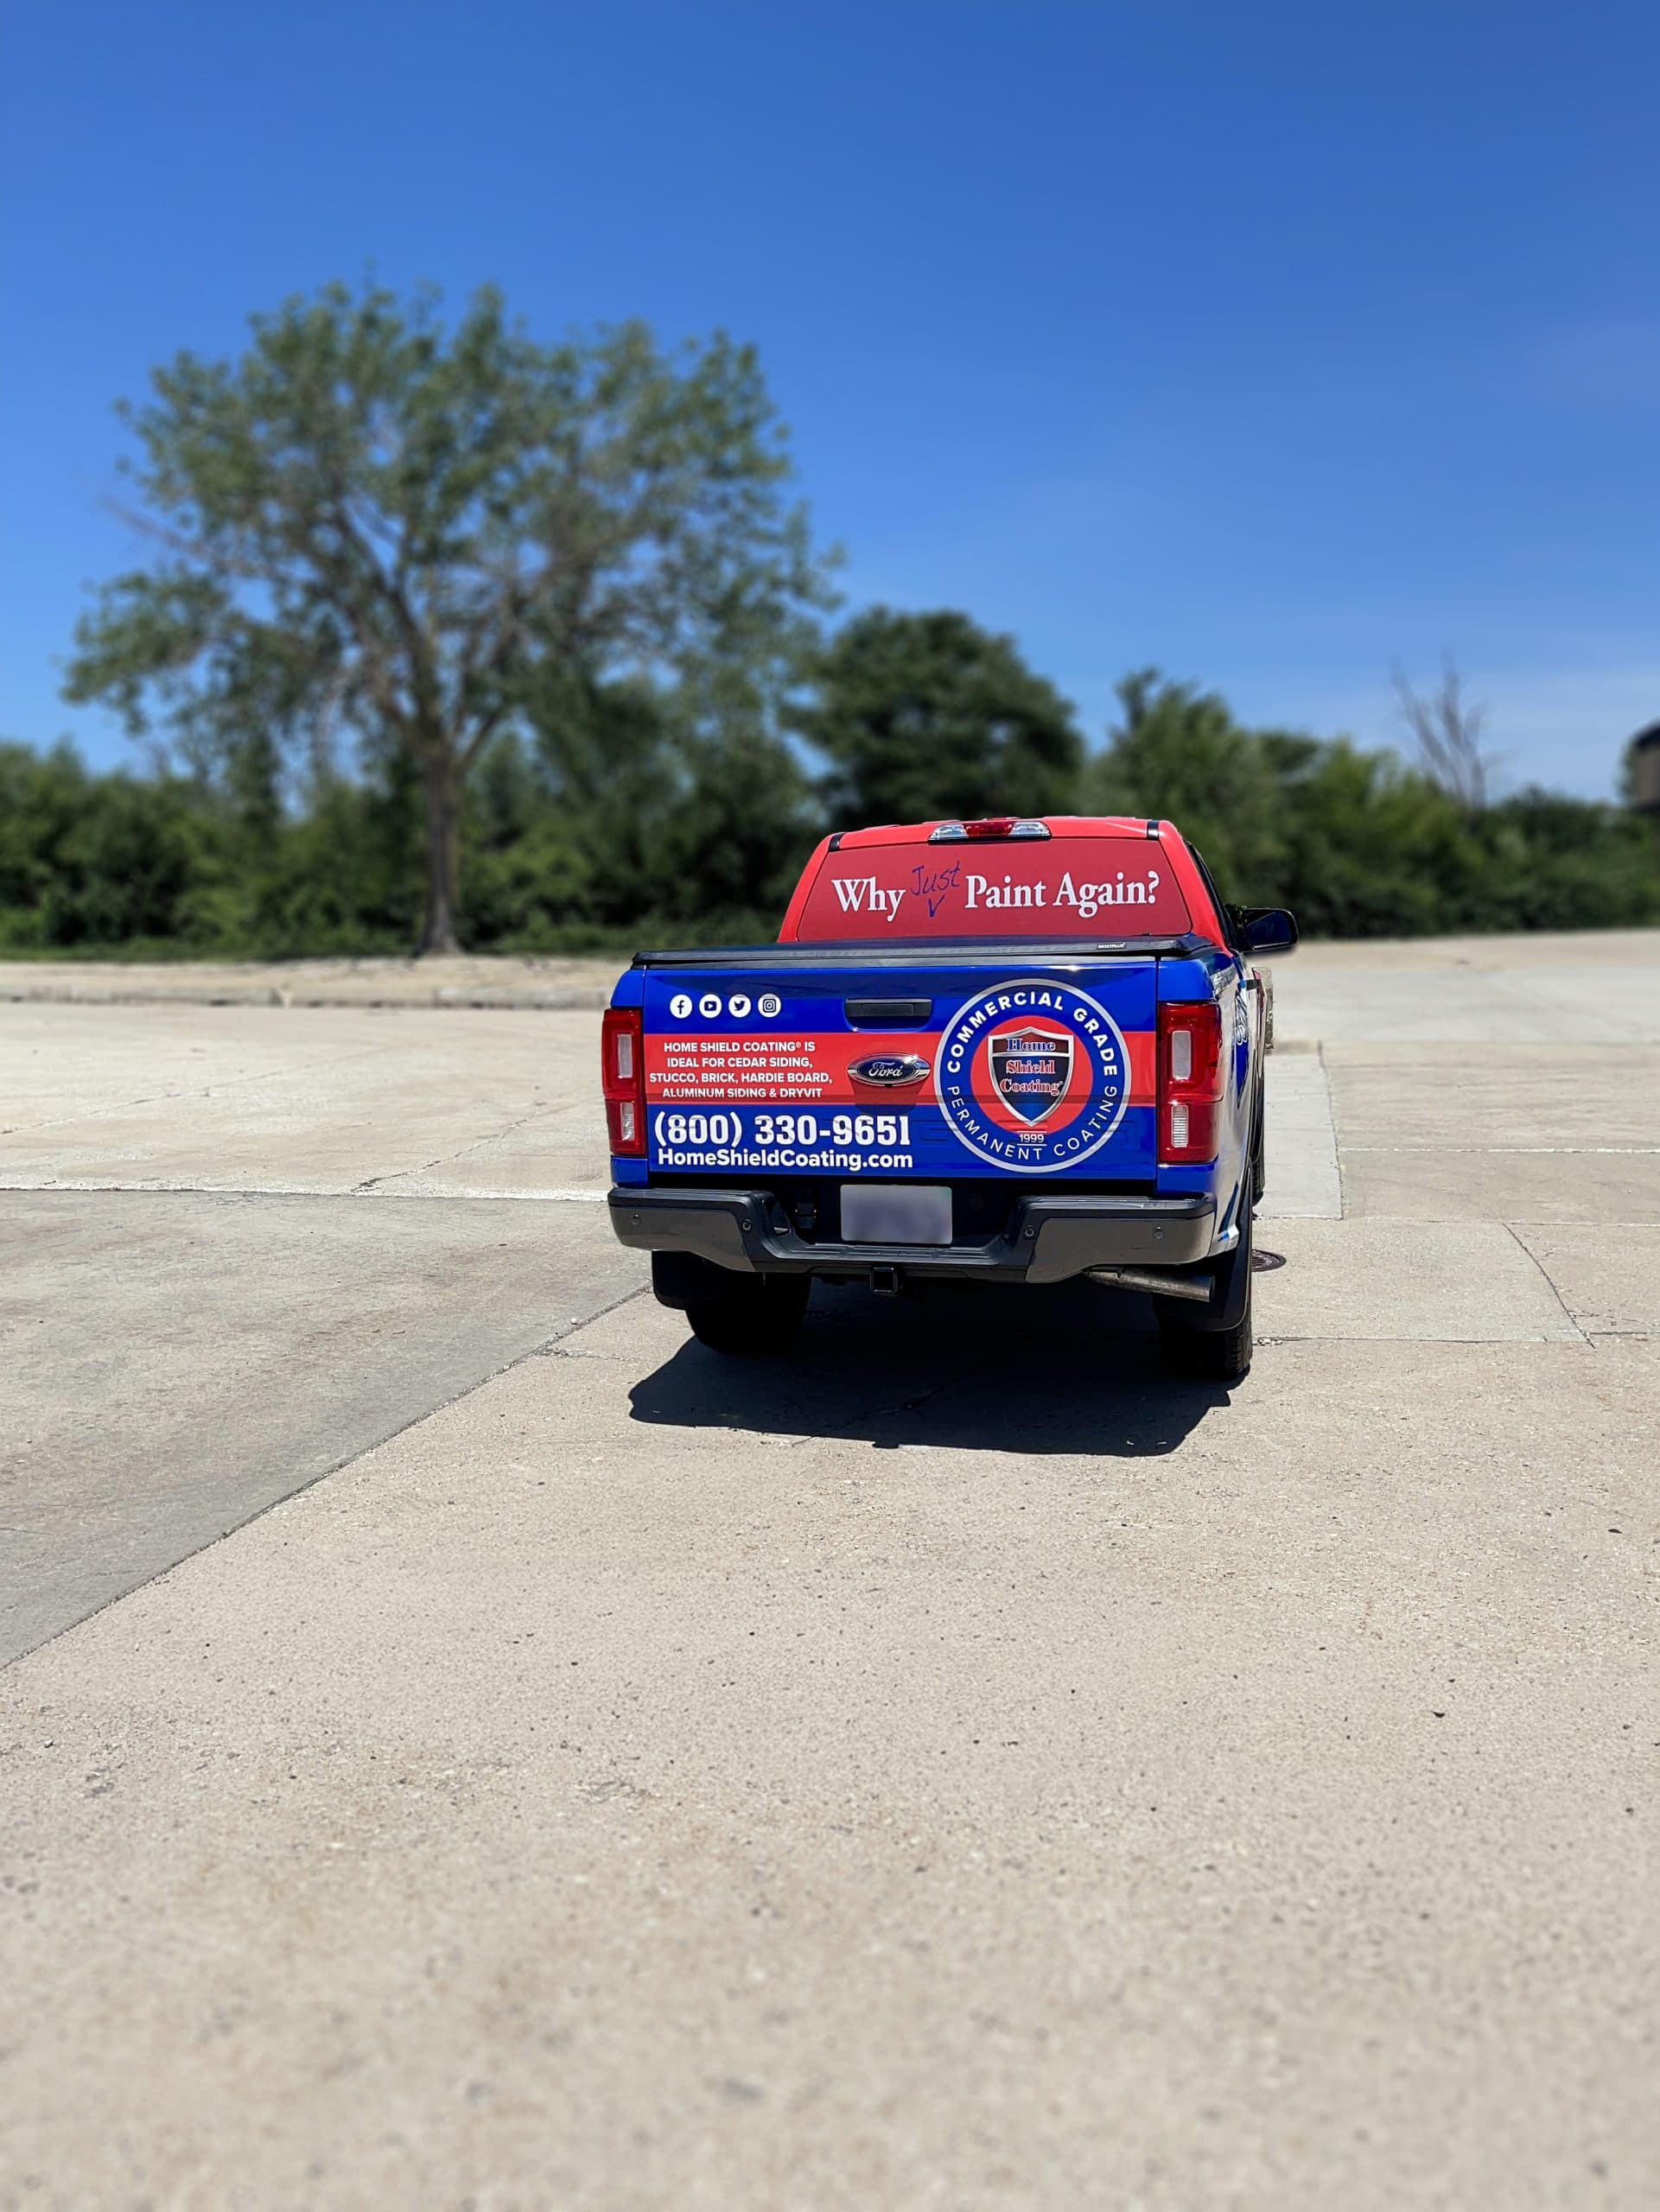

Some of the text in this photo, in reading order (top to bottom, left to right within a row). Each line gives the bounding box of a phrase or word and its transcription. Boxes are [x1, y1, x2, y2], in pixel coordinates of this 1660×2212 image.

[831, 861, 1160, 922] Why Just Paint Again?
[947, 991, 1117, 1076] COMMERCIAL GRADE
[664, 1042, 697, 1052] HOME
[700, 1041, 741, 1052] SHIELD
[804, 1041, 816, 1052] IS
[1006, 1038, 1056, 1052] Home
[667, 1057, 813, 1069] IDEAL FOR CEDAR SIDING,
[868, 1061, 903, 1077] Ford
[1006, 1059, 1055, 1074] Shield
[649, 1072, 833, 1084] STUCCO, BRICK, HARDIE BOARD,
[662, 1088, 823, 1098] ALUMINUM SIDING & DRYVIT
[654, 1111, 911, 1147] (800) 330-9651
[947, 1085, 1117, 1160] PERMANENT COATING
[1019, 1134, 1045, 1143] 1999
[658, 1148, 913, 1172] HomeShieldCoating.com
